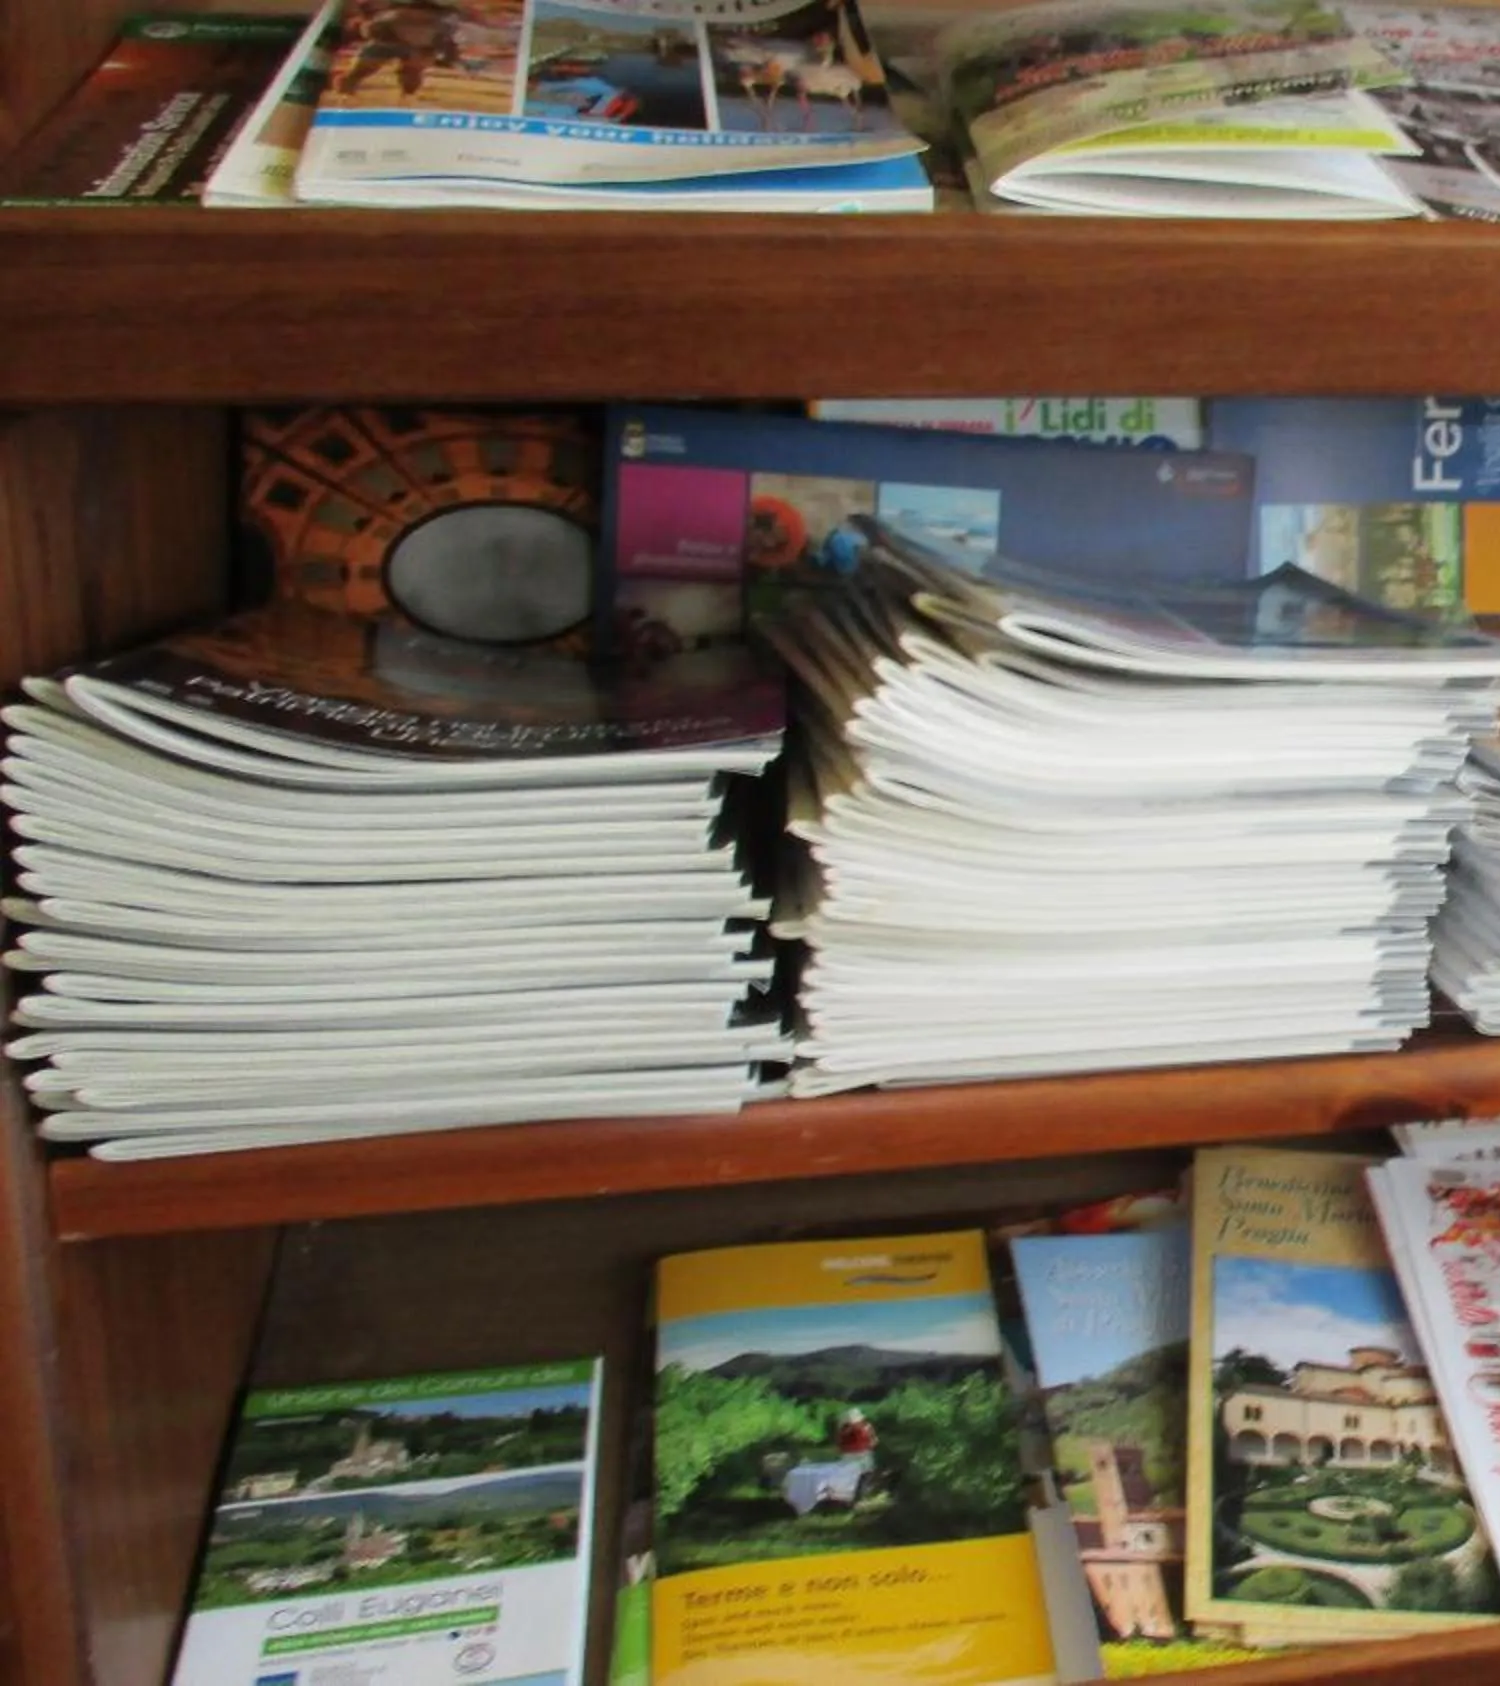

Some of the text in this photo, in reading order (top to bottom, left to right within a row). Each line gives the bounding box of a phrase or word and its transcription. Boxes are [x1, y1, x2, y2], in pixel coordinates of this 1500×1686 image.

[412, 112, 529, 133] Enjoy
[544, 123, 636, 142] your
[1040, 398, 1106, 432] Lidi
[1119, 400, 1155, 432] di
[266, 1578, 504, 1630] Colli Euganei
[682, 1584, 769, 1610] Terme
[778, 1581, 797, 1597] e
[805, 1574, 860, 1593] non
